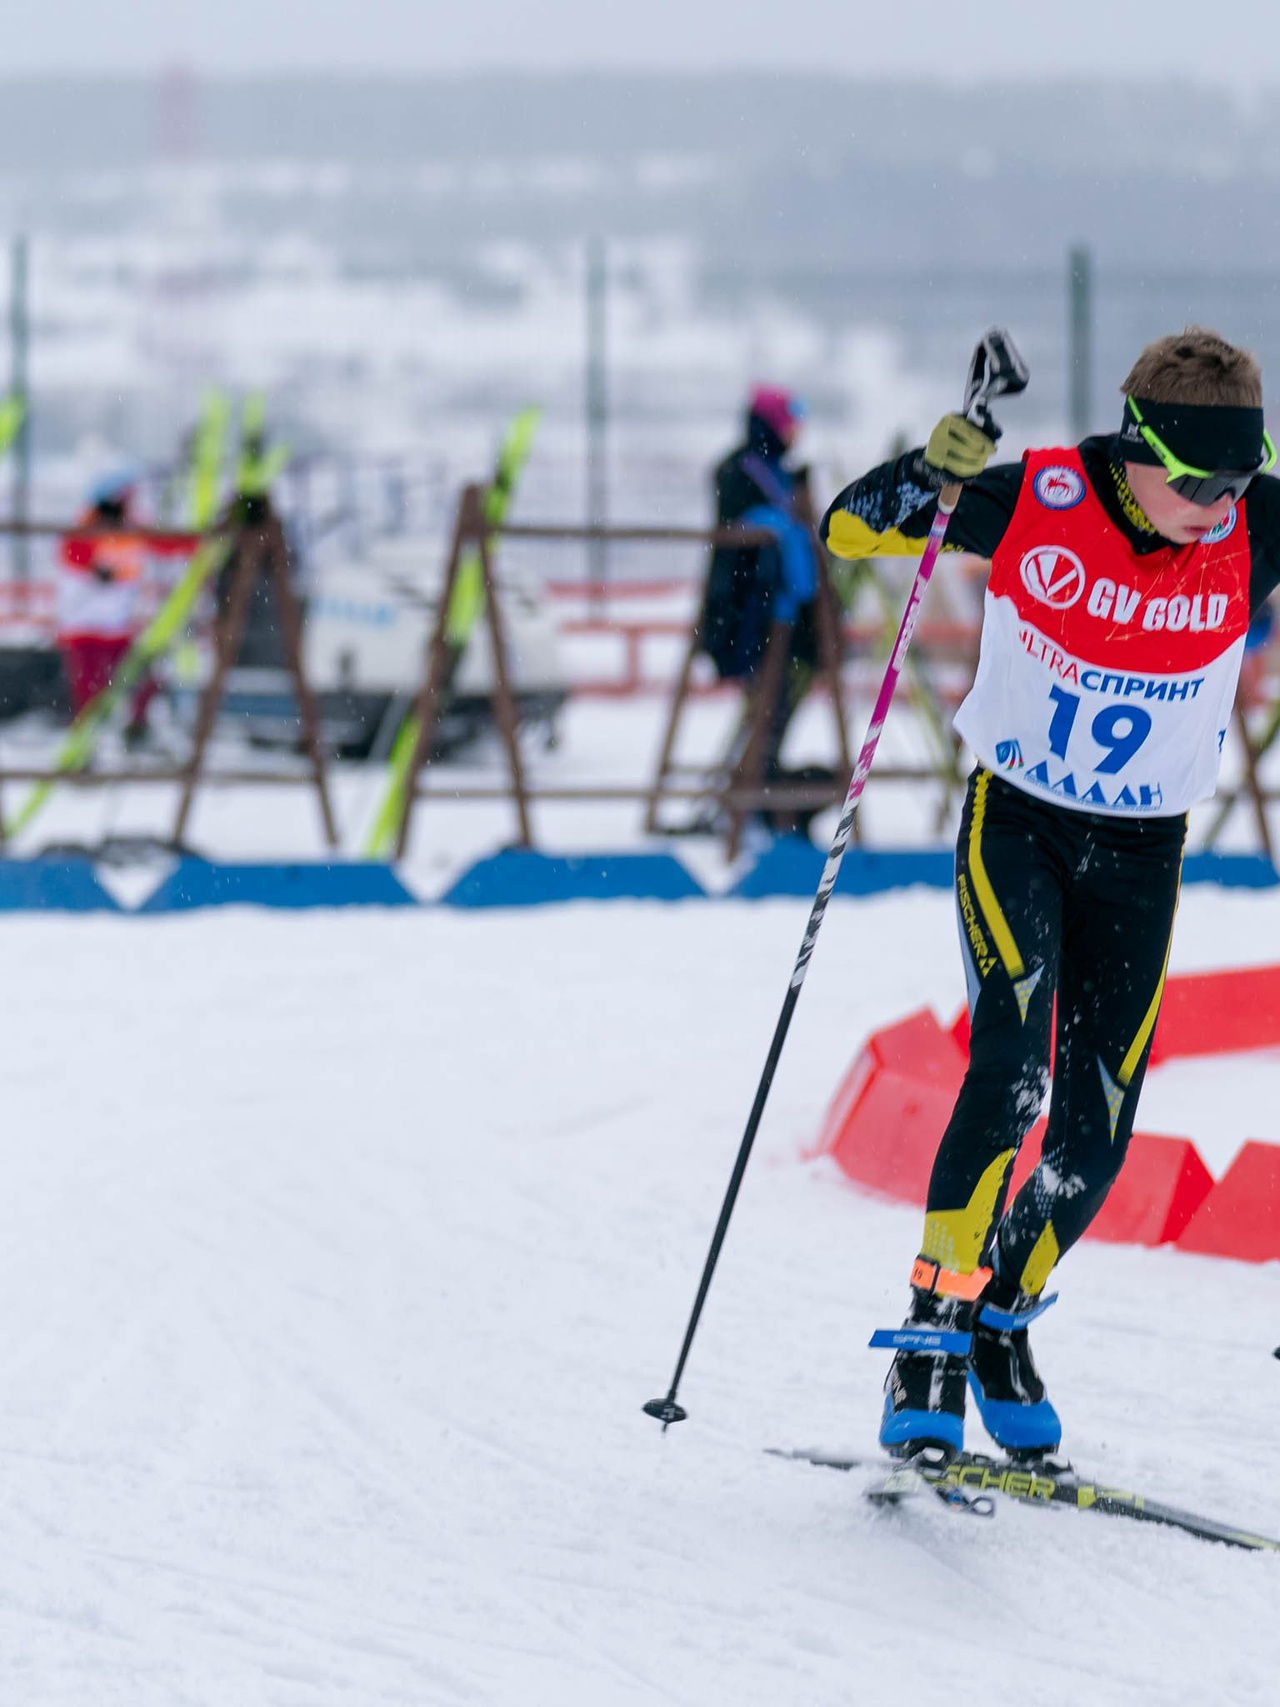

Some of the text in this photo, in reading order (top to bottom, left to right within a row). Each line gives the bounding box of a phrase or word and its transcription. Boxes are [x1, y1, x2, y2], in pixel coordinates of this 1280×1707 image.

[1087, 577, 1229, 633] GV GOLD
[1047, 682, 1152, 775] 19
[958, 873, 989, 959] FISCHER
[925, 1464, 1056, 1500] SCHER
